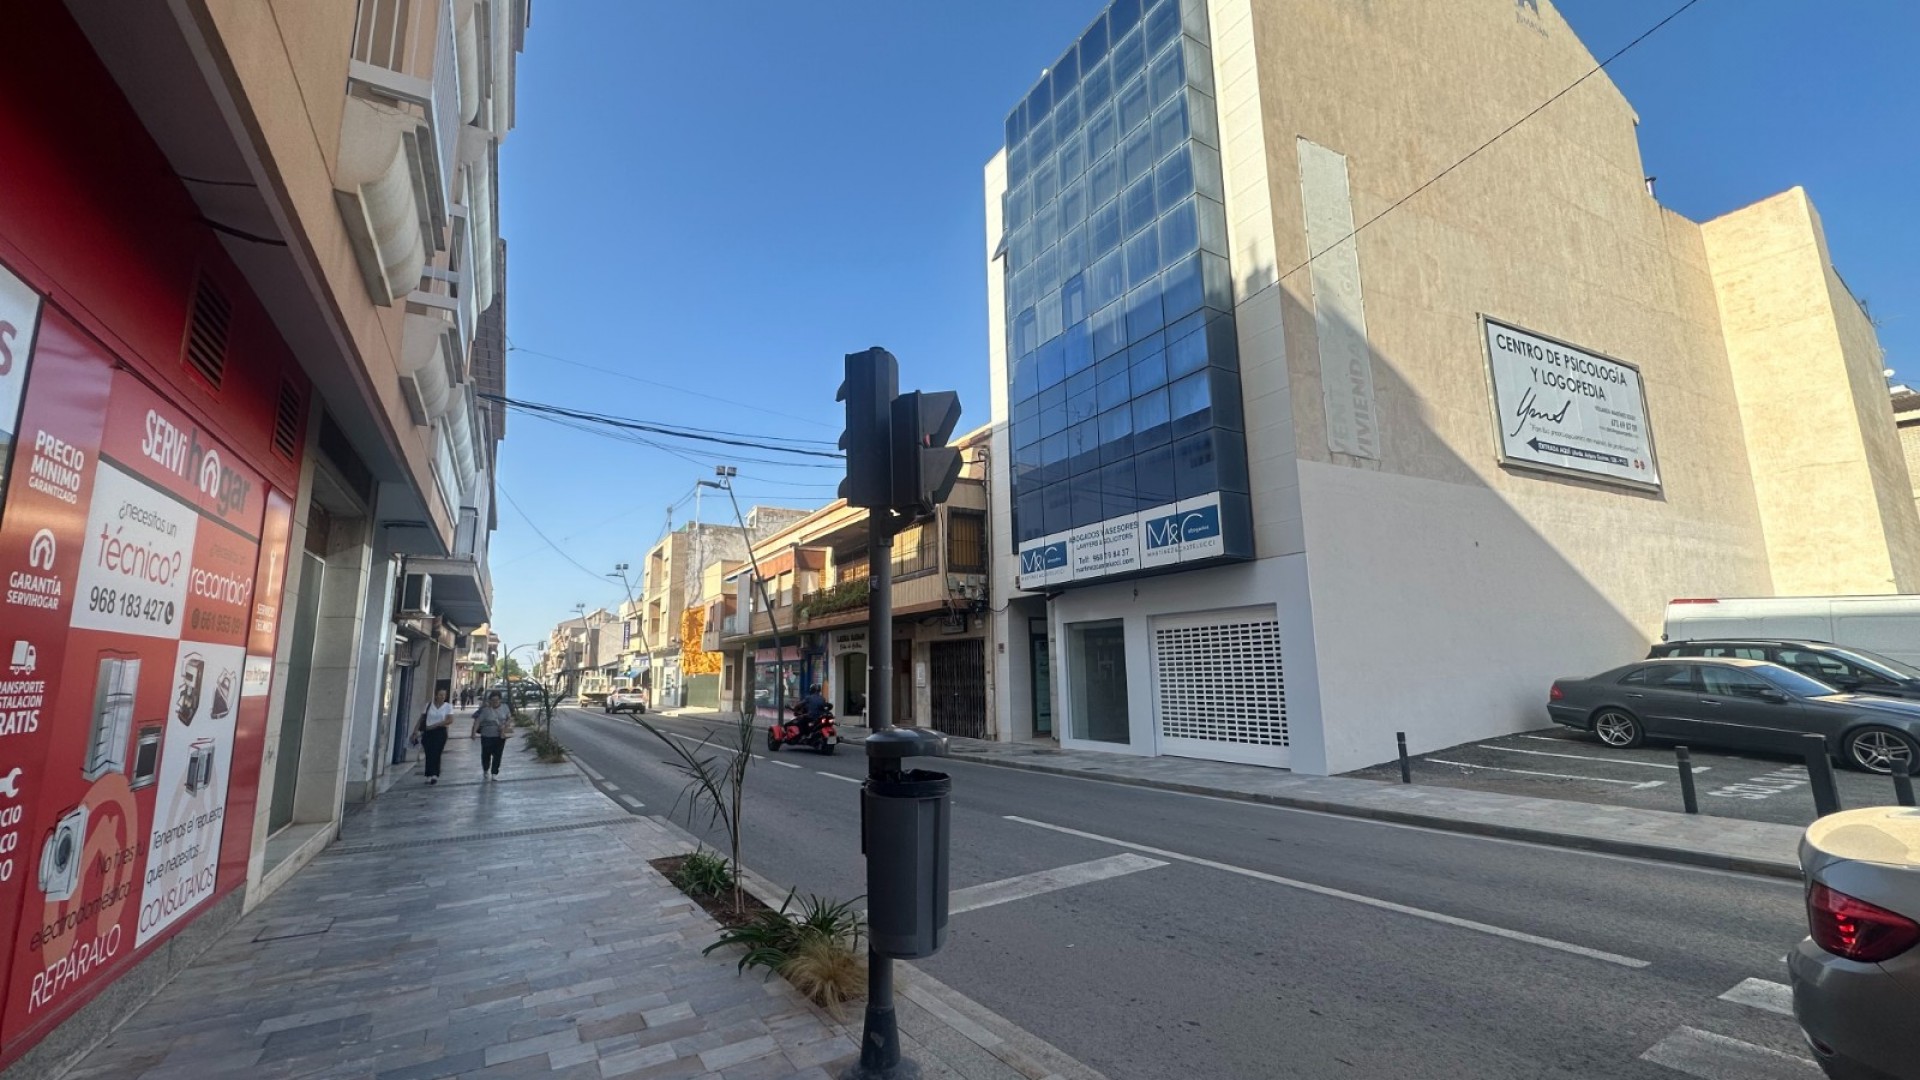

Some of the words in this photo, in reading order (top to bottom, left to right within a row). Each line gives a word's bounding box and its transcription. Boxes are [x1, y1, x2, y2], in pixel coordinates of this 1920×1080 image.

[1496, 334, 1543, 361] CENTRO
[1547, 349, 1561, 366] DE
[1565, 355, 1627, 387] PSICOLOGÍA
[1531, 366, 1538, 382] Y
[1542, 370, 1607, 401] LOGOPEDIA
[35, 430, 84, 471] PRECIO
[28, 477, 77, 505] GARANTIZADO
[31, 456, 80, 492] MINIMO
[119, 500, 166, 534] ¿necesitas
[166, 520, 177, 537] un
[1068, 531, 1100, 544] ABOGADOS
[1104, 520, 1139, 536] ASESORES
[1147, 513, 1203, 550] M&C
[98, 523, 181, 587] técnico?
[6, 590, 59, 611] SERVIHOGAR
[9, 570, 62, 596] GARANTÍA
[189, 567, 252, 607] recambio?
[89, 586, 117, 614] 968
[119, 590, 141, 619] 183
[143, 597, 165, 622] 427
[152, 822, 187, 850] Tenemos
[187, 815, 194, 834] el
[146, 863, 164, 889] que
[139, 863, 215, 934] CONSÚLTANOS
[28, 923, 122, 1014] REPÁRALO
